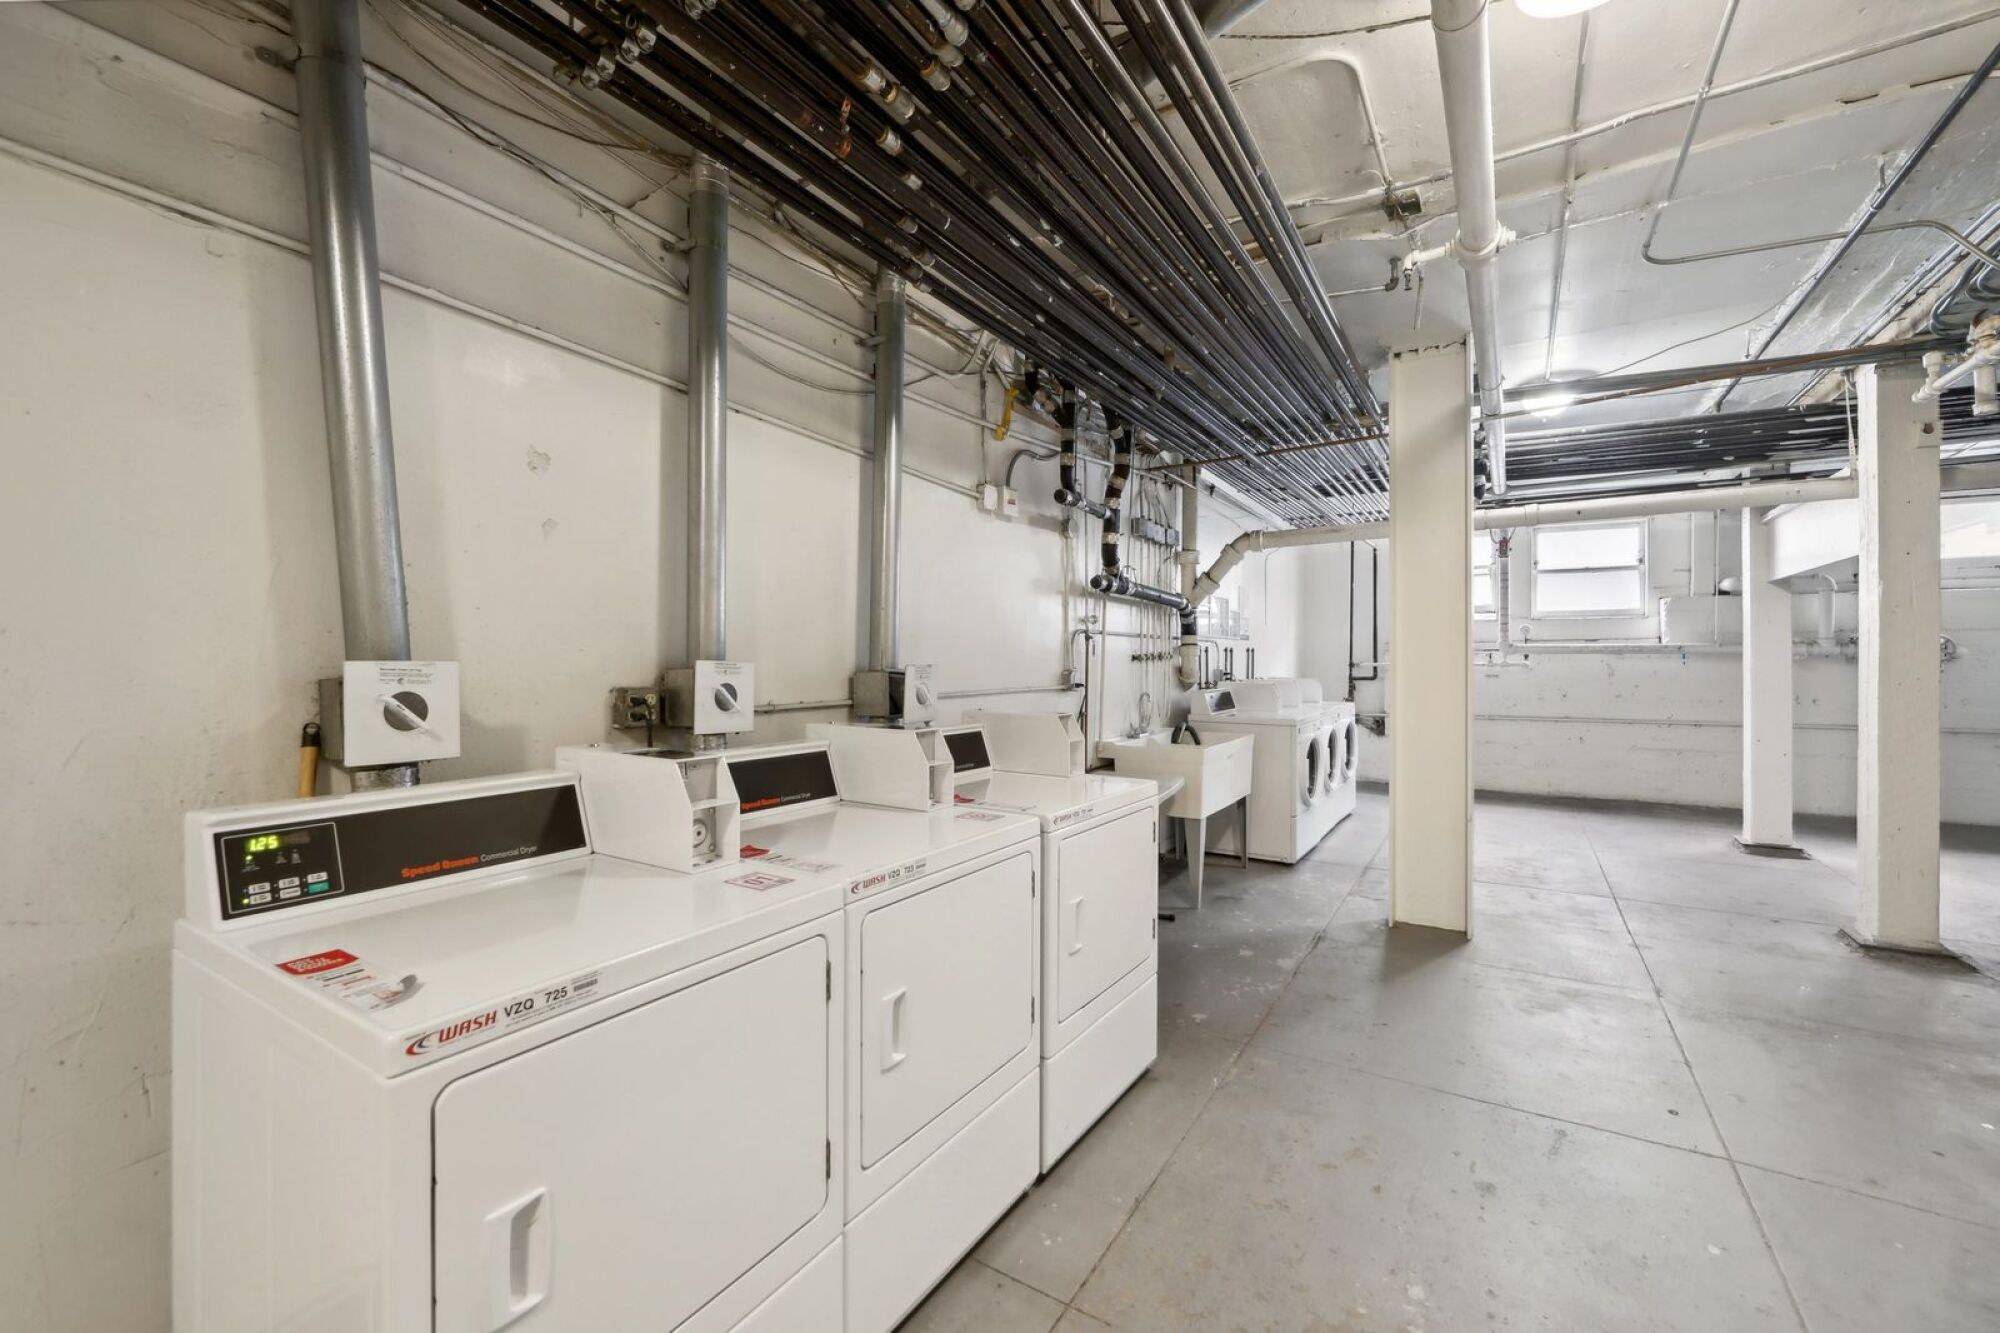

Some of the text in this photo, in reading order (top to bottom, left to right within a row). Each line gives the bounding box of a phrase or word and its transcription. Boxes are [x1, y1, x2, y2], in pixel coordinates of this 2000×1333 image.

[401, 846, 537, 878] Speed Queen Commercial Dryer
[439, 1011, 497, 1043] WASH
[504, 998, 535, 1018] VZQ
[544, 986, 568, 1004] 725
